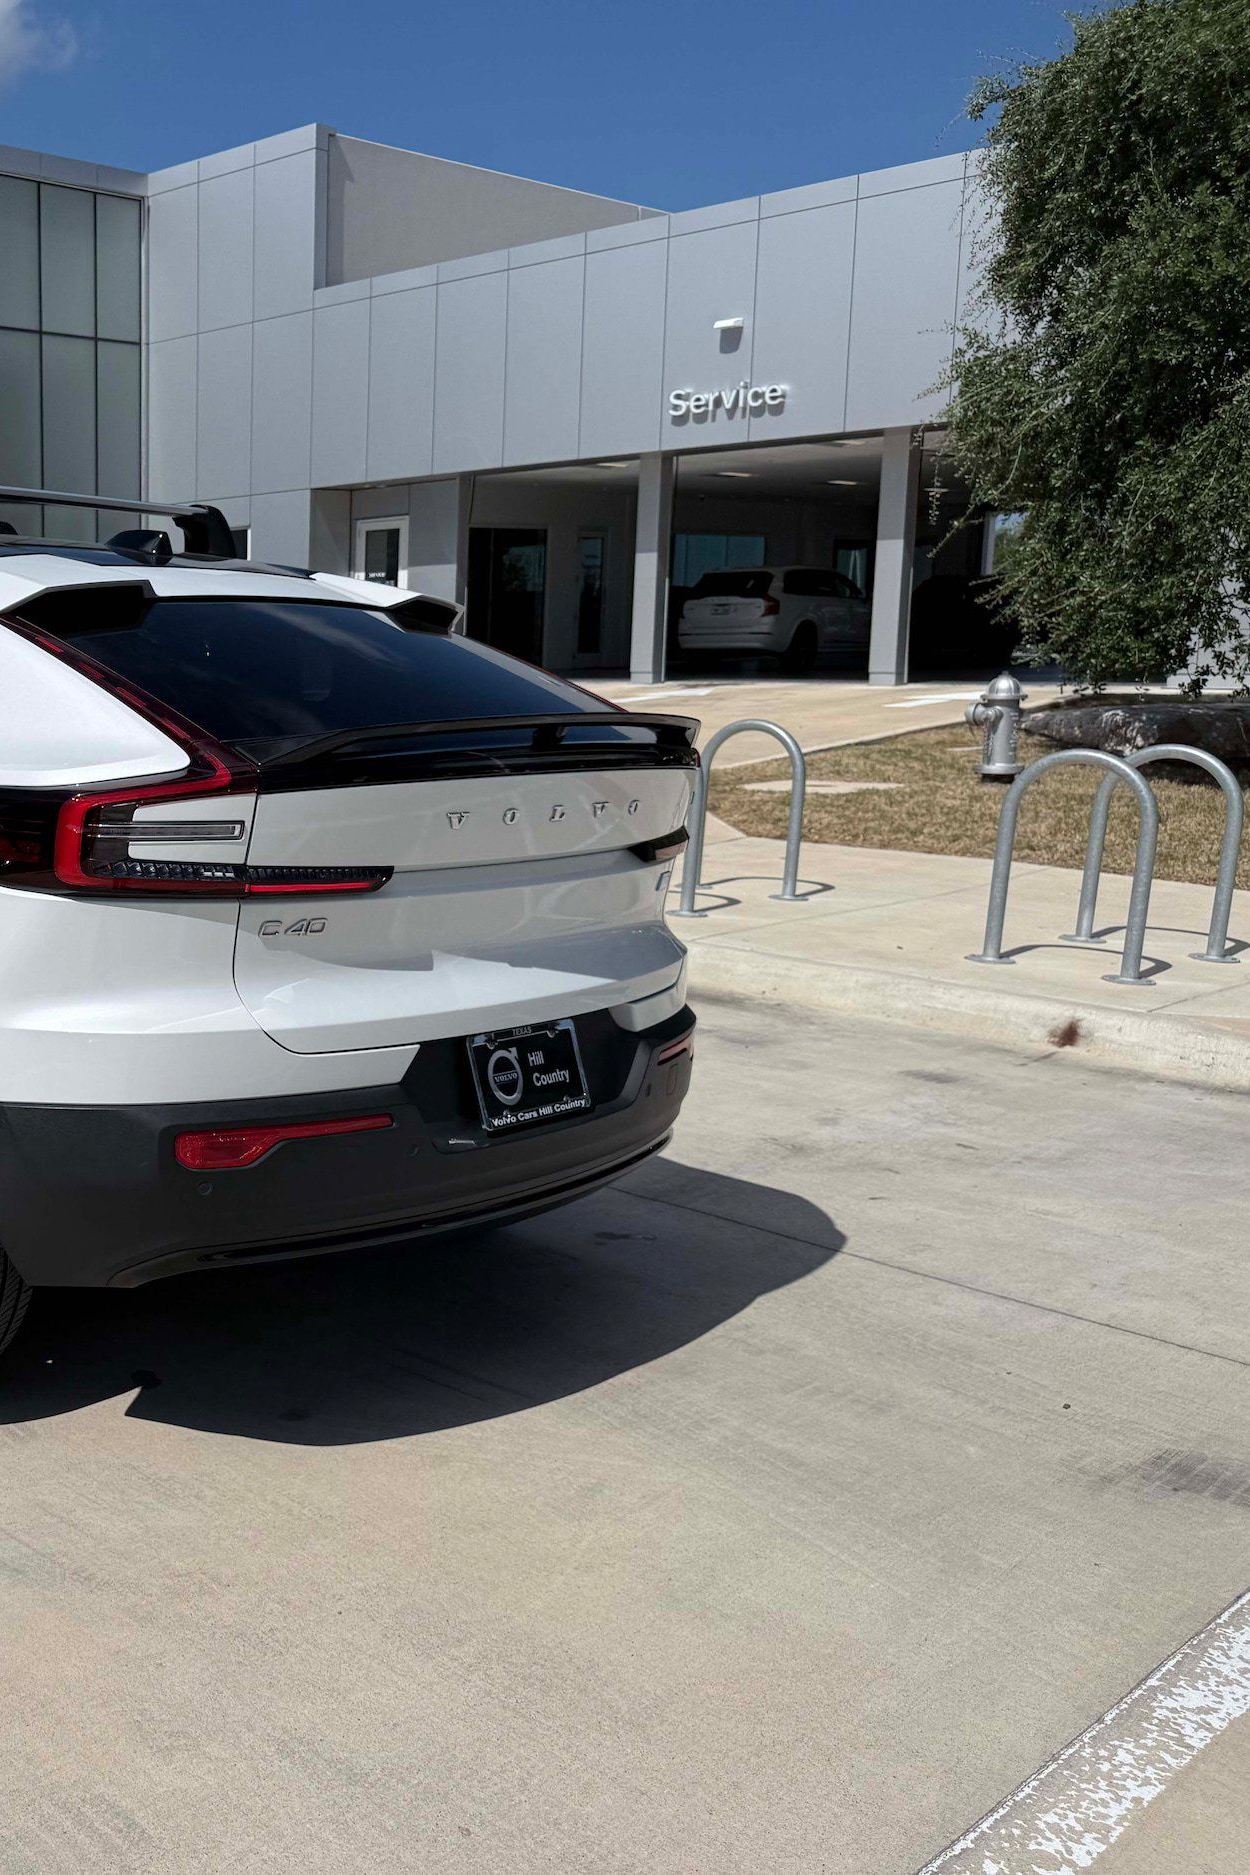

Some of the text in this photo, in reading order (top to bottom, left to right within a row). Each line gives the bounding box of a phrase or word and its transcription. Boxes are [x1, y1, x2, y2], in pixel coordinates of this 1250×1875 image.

[668, 380, 786, 417] Service
[446, 800, 640, 830] VOLVO
[258, 917, 328, 939] C40
[511, 1026, 532, 1036] TEXAS
[527, 1050, 545, 1067] Hill
[494, 1072, 518, 1083] VOLVO
[532, 1069, 570, 1087] Country
[491, 1098, 586, 1128] Volvo Cars Hill Country
